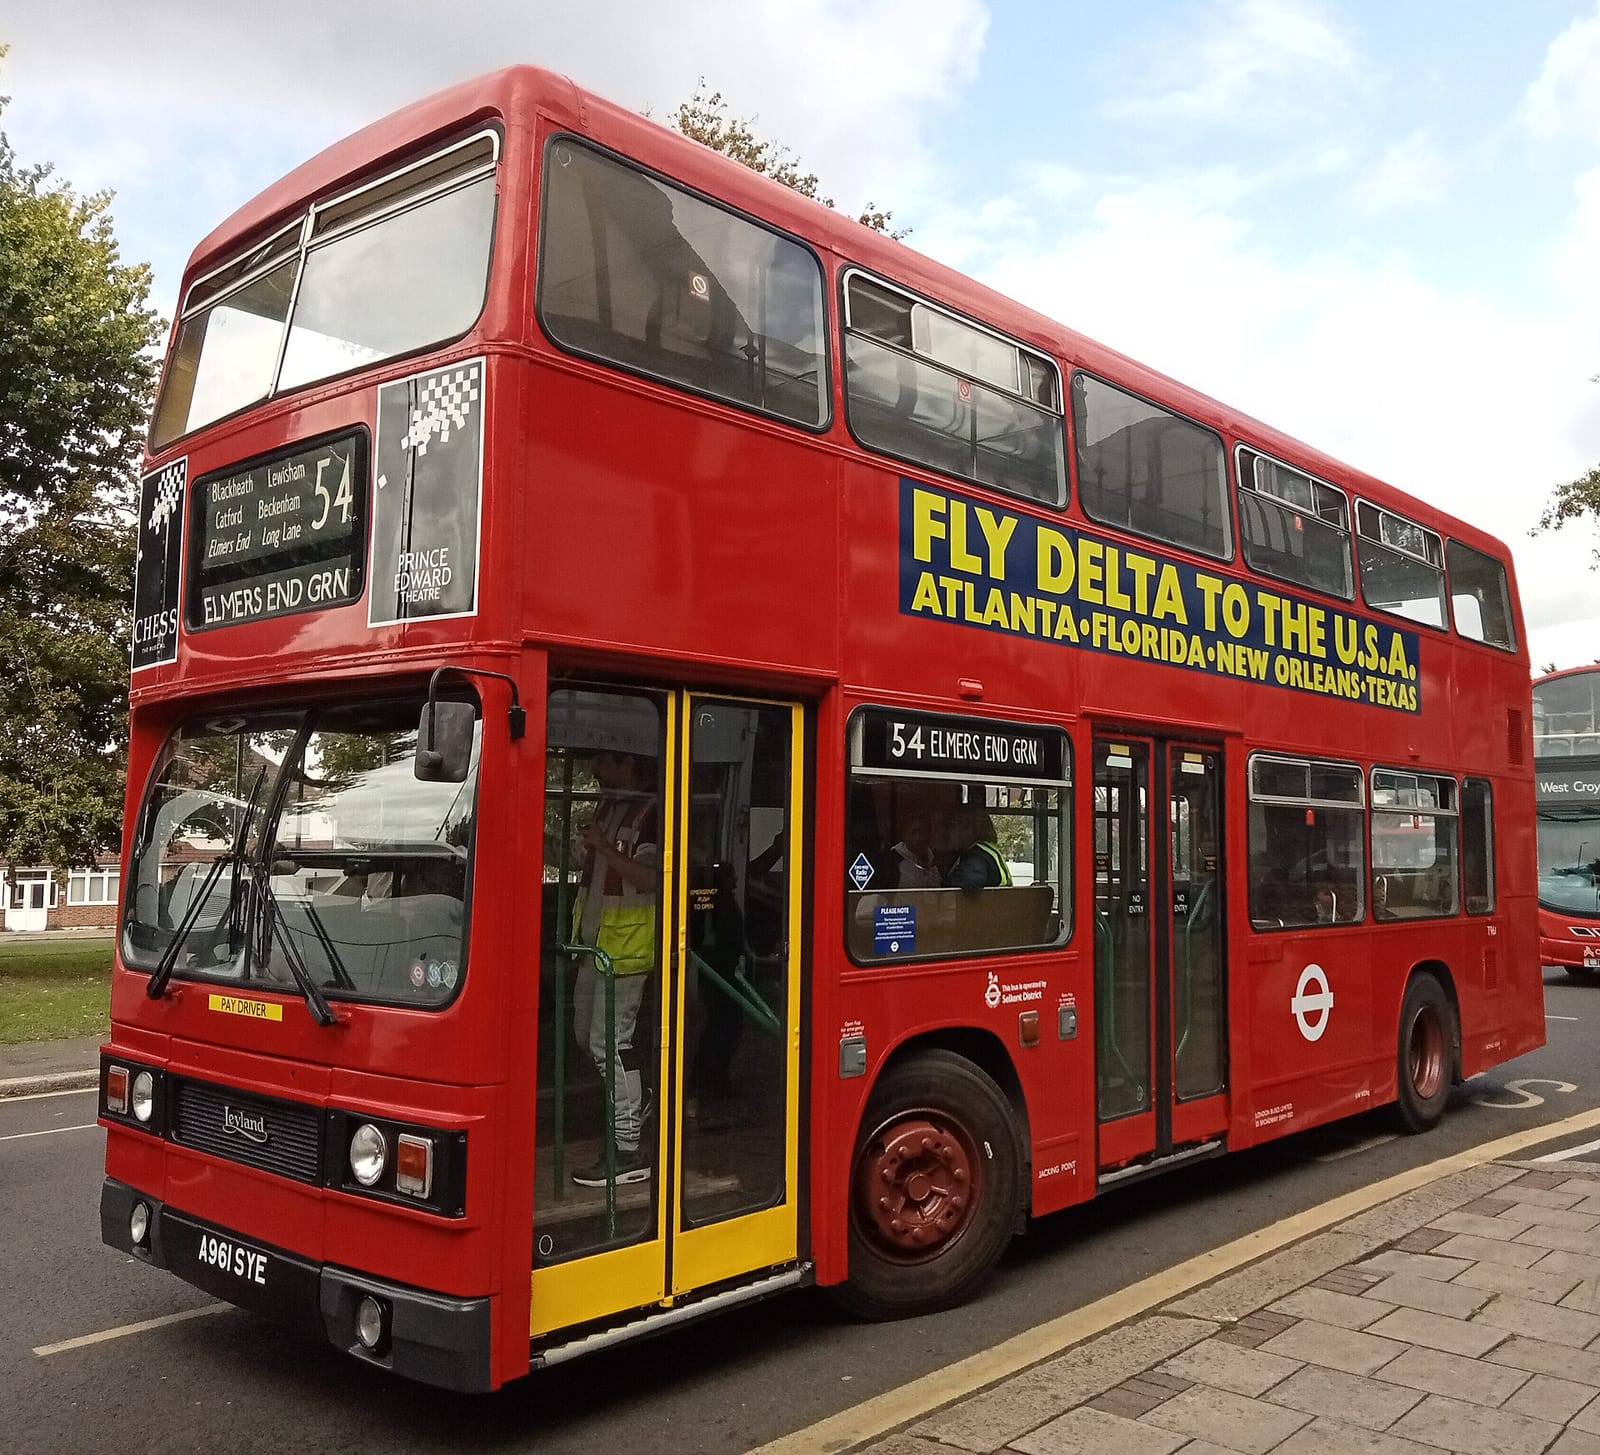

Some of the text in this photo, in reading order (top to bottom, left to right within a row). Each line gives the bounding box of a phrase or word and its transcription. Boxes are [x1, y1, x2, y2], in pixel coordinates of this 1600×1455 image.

[212, 461, 305, 503] Blackheath Lewisham
[311, 453, 353, 531] 54
[215, 494, 301, 530] Catford Beckenham
[208, 531, 251, 559] Elmers End
[262, 523, 301, 549] Long Lane
[398, 548, 449, 574] PRINCE
[394, 567, 452, 592] EDWARD
[913, 488, 1417, 680] FLY DELTA TO THE U.S.A.
[204, 568, 349, 624] ELMERS END GRN
[400, 587, 441, 603] THEATRE
[134, 608, 177, 643] CHESS
[911, 571, 1417, 712] ATLANTA FLORIDA NEW ORLEANS TEXAS
[891, 723, 1038, 765] 54 ELMERS END GRN
[1540, 780, 1600, 795] West Croy
[1128, 905, 1144, 914] ENTRY
[1132, 894, 1141, 903] NO
[1173, 904, 1188, 914] ENTRY
[1176, 894, 1185, 902] NO
[221, 998, 267, 1017] PAY DRIVER
[1022, 990, 1042, 1001] District
[222, 1106, 268, 1143] Leyland
[1038, 1160, 1076, 1179] JACKING POINT
[198, 1234, 268, 1285] A961 SYE
